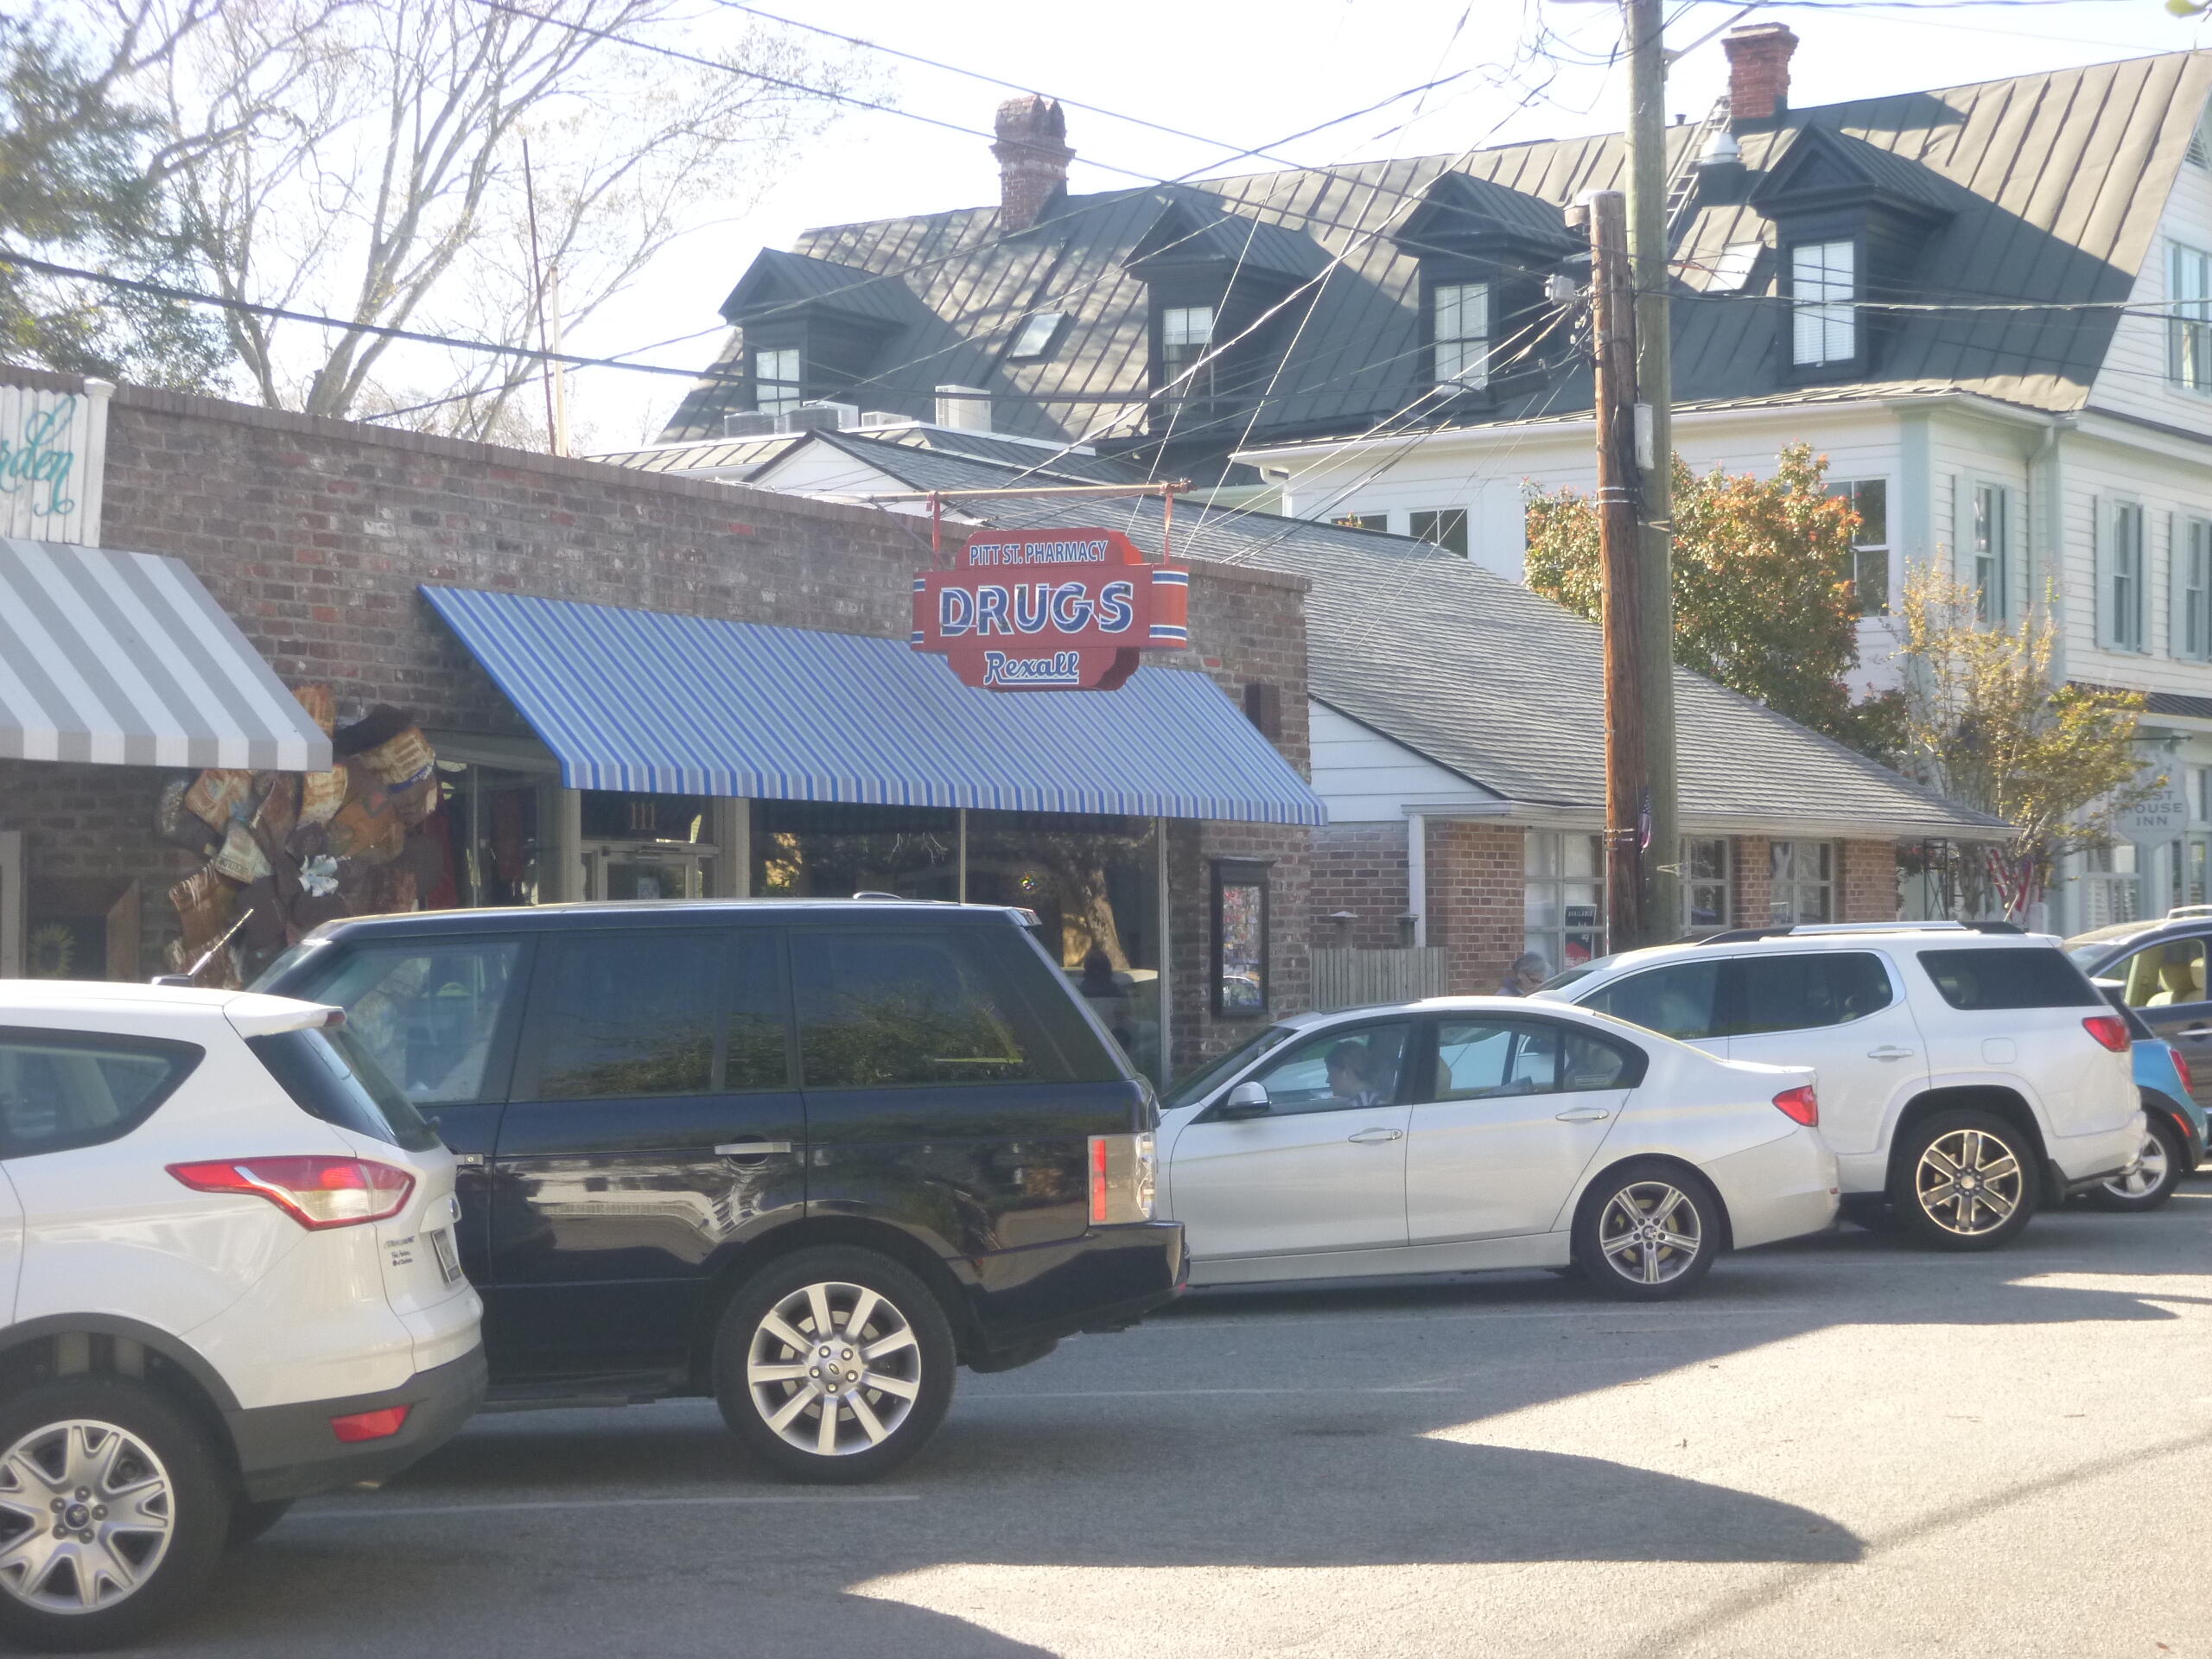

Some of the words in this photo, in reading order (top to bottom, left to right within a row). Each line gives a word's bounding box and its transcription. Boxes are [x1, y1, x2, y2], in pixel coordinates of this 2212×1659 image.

[969, 544, 1001, 566] PITT
[1002, 543, 1023, 565] ST.
[1026, 540, 1109, 563] PHARMACY
[940, 582, 1134, 638] DRUGS
[983, 651, 1079, 685] Rexall
[2136, 816, 2168, 827] INN
